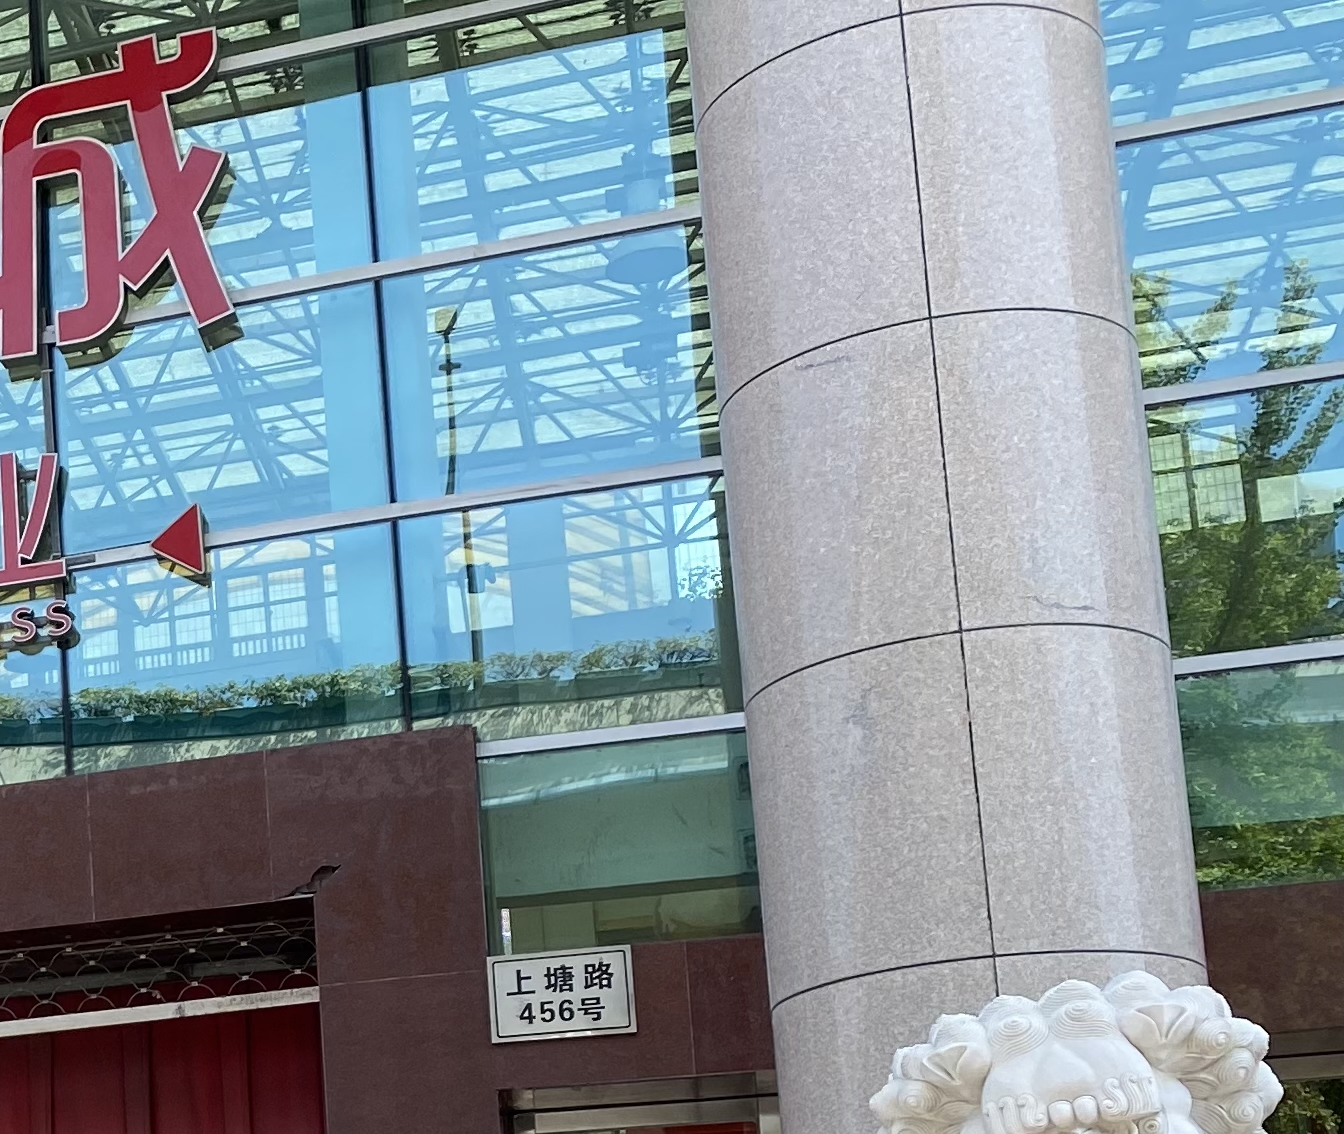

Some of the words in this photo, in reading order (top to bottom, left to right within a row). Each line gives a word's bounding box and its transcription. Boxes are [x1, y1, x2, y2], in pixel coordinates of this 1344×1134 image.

[506, 960, 614, 996] 上塘路
[519, 996, 605, 1025] 456号
